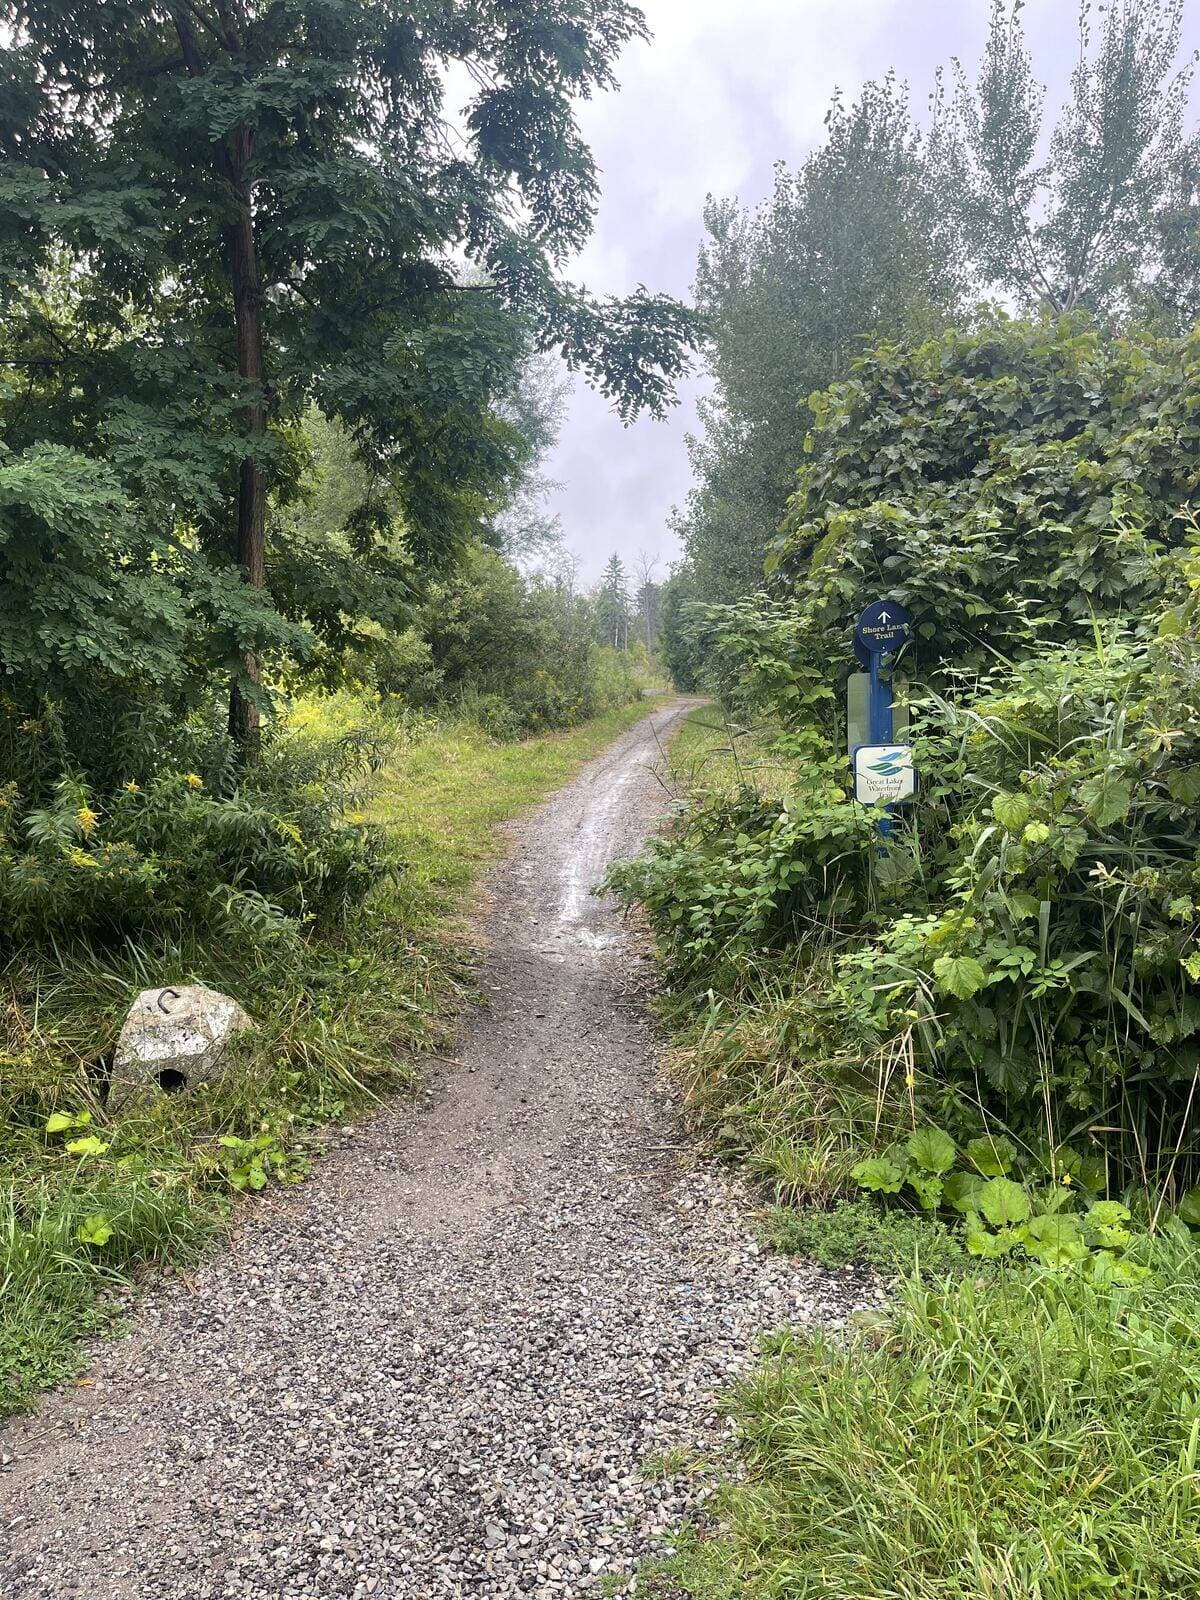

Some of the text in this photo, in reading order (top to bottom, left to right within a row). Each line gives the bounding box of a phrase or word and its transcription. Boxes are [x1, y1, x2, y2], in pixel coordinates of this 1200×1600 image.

[862, 624, 905, 634] Shore Lan
[874, 631, 894, 640] Trail
